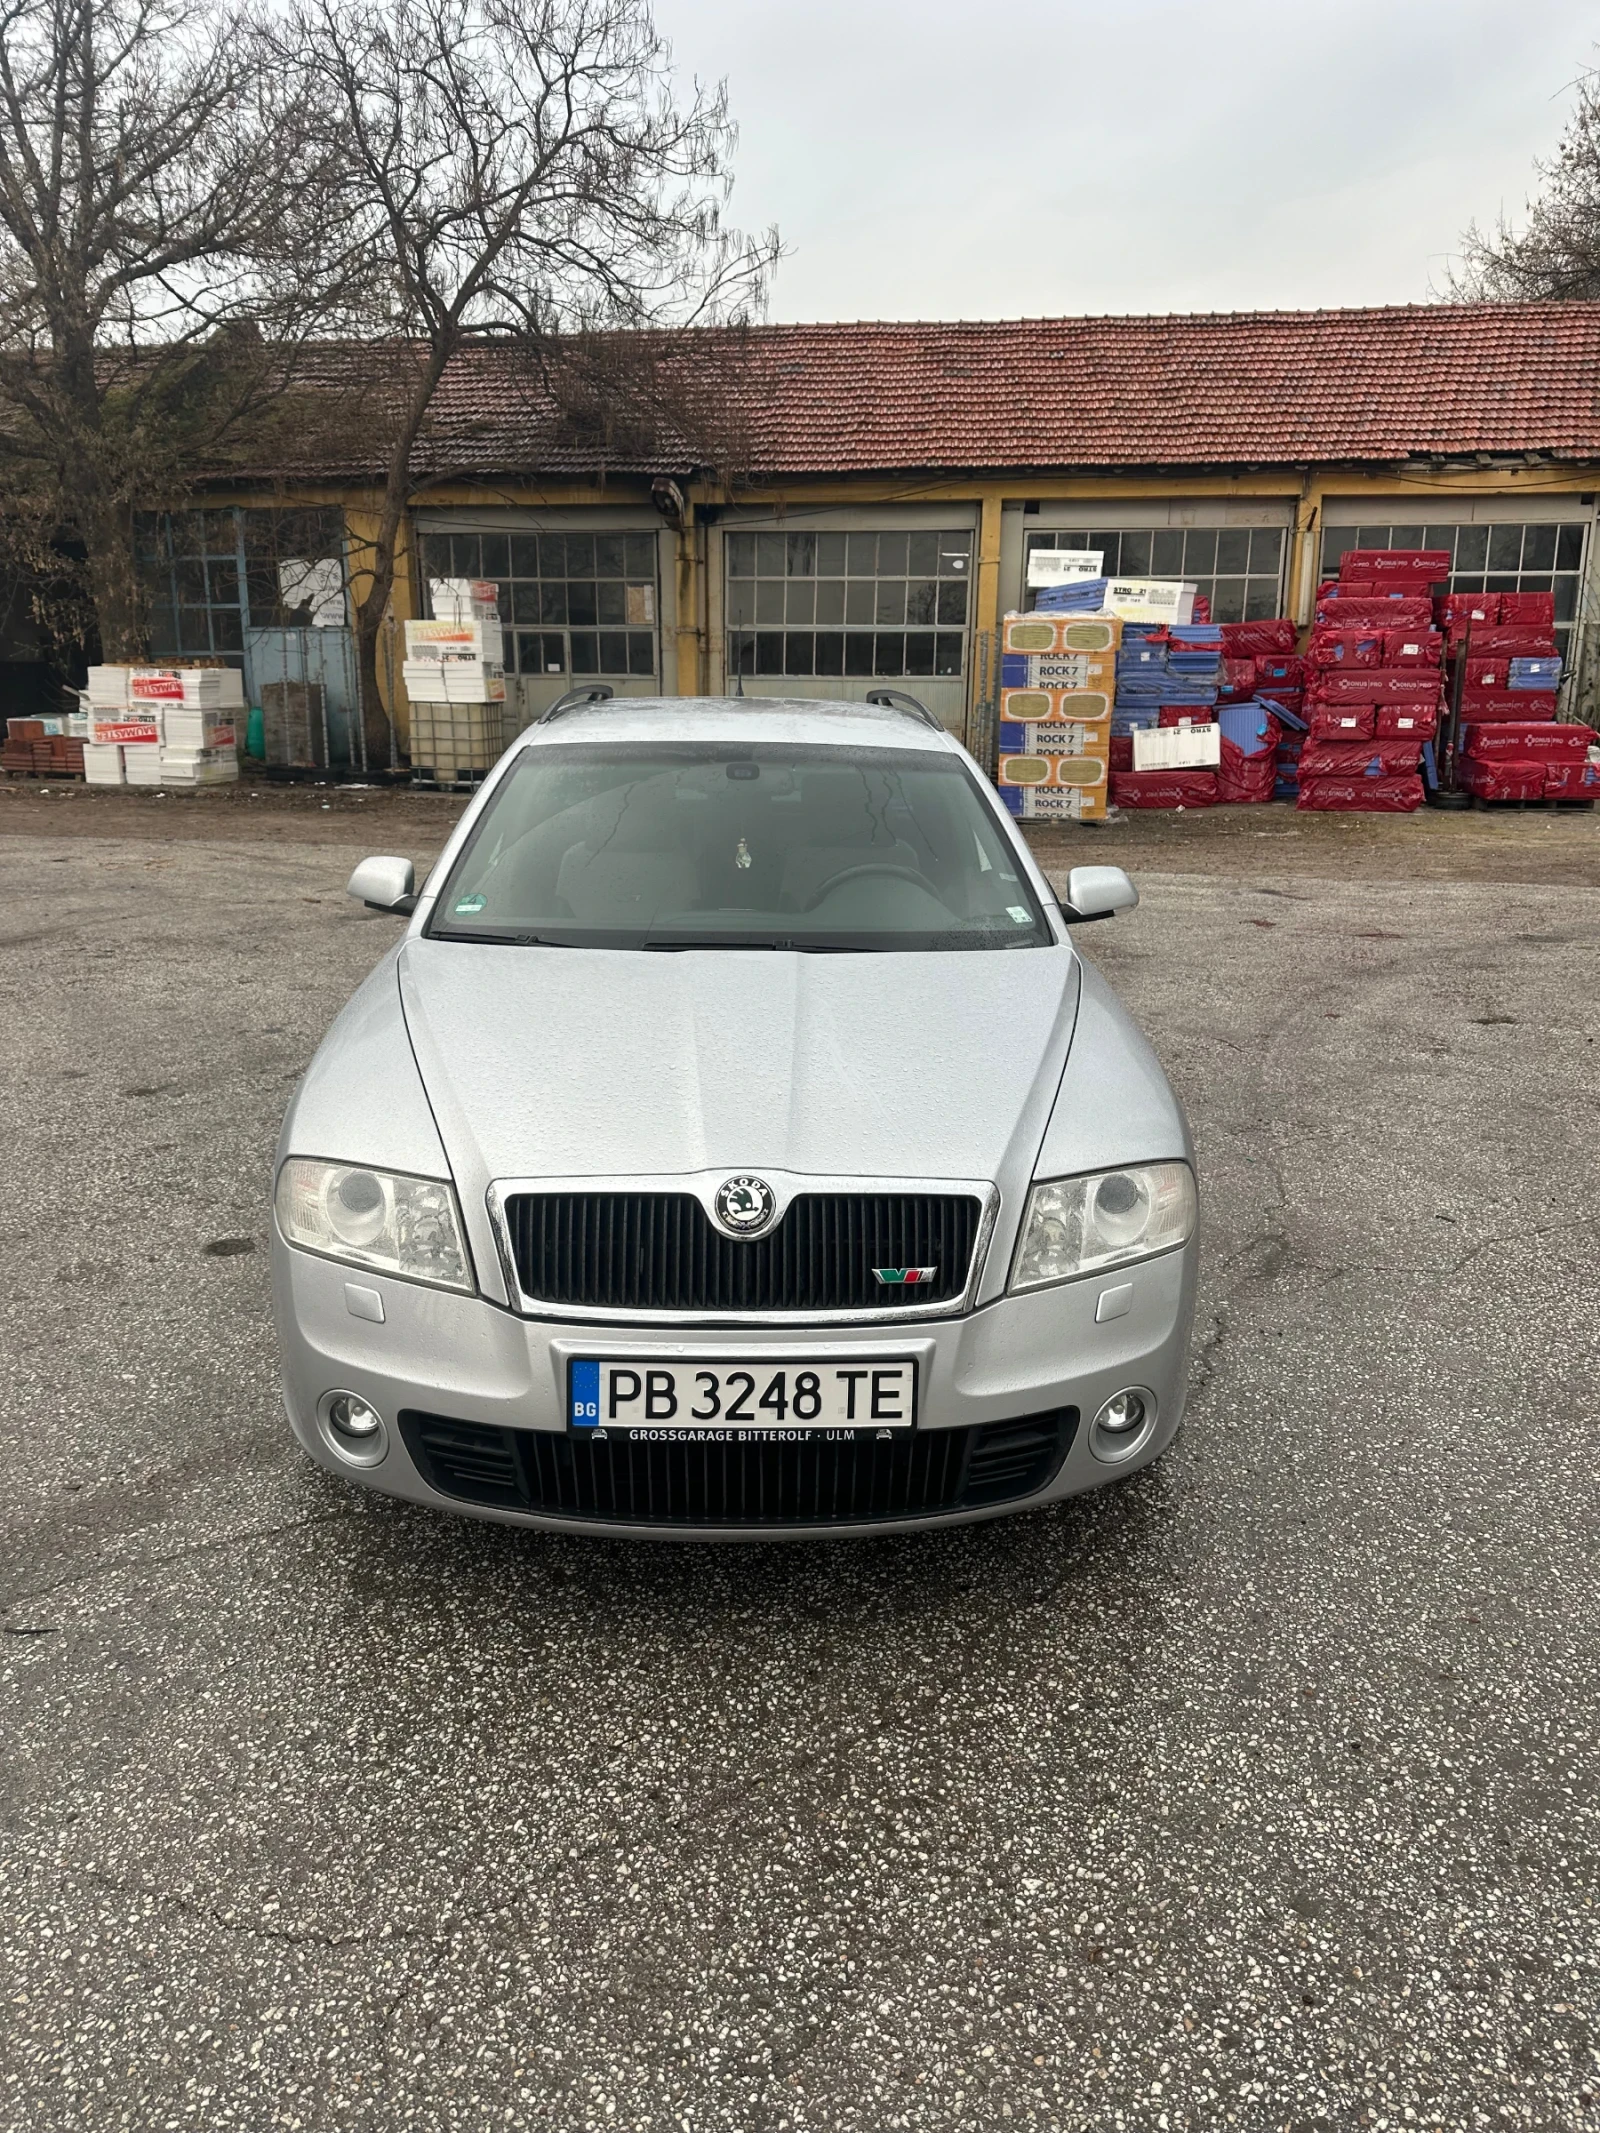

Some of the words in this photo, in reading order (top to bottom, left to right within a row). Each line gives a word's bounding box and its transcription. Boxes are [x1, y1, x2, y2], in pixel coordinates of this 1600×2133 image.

[1040, 666, 1070, 676] ROCK
[1072, 667, 1078, 675] 7
[96, 724, 156, 740] BAUMASTER
[1036, 734, 1067, 743] ROCK
[1068, 735, 1074, 743] 7
[1035, 800, 1065, 808] ROCK
[574, 1402, 596, 1417] BG
[609, 1370, 678, 1419] PB
[692, 1371, 822, 1420] 3248
[836, 1370, 902, 1419] TE
[629, 1429, 733, 1441] GROSSGARAGE
[738, 1430, 812, 1441] BITTEROLF
[826, 1430, 855, 1441] ULM
